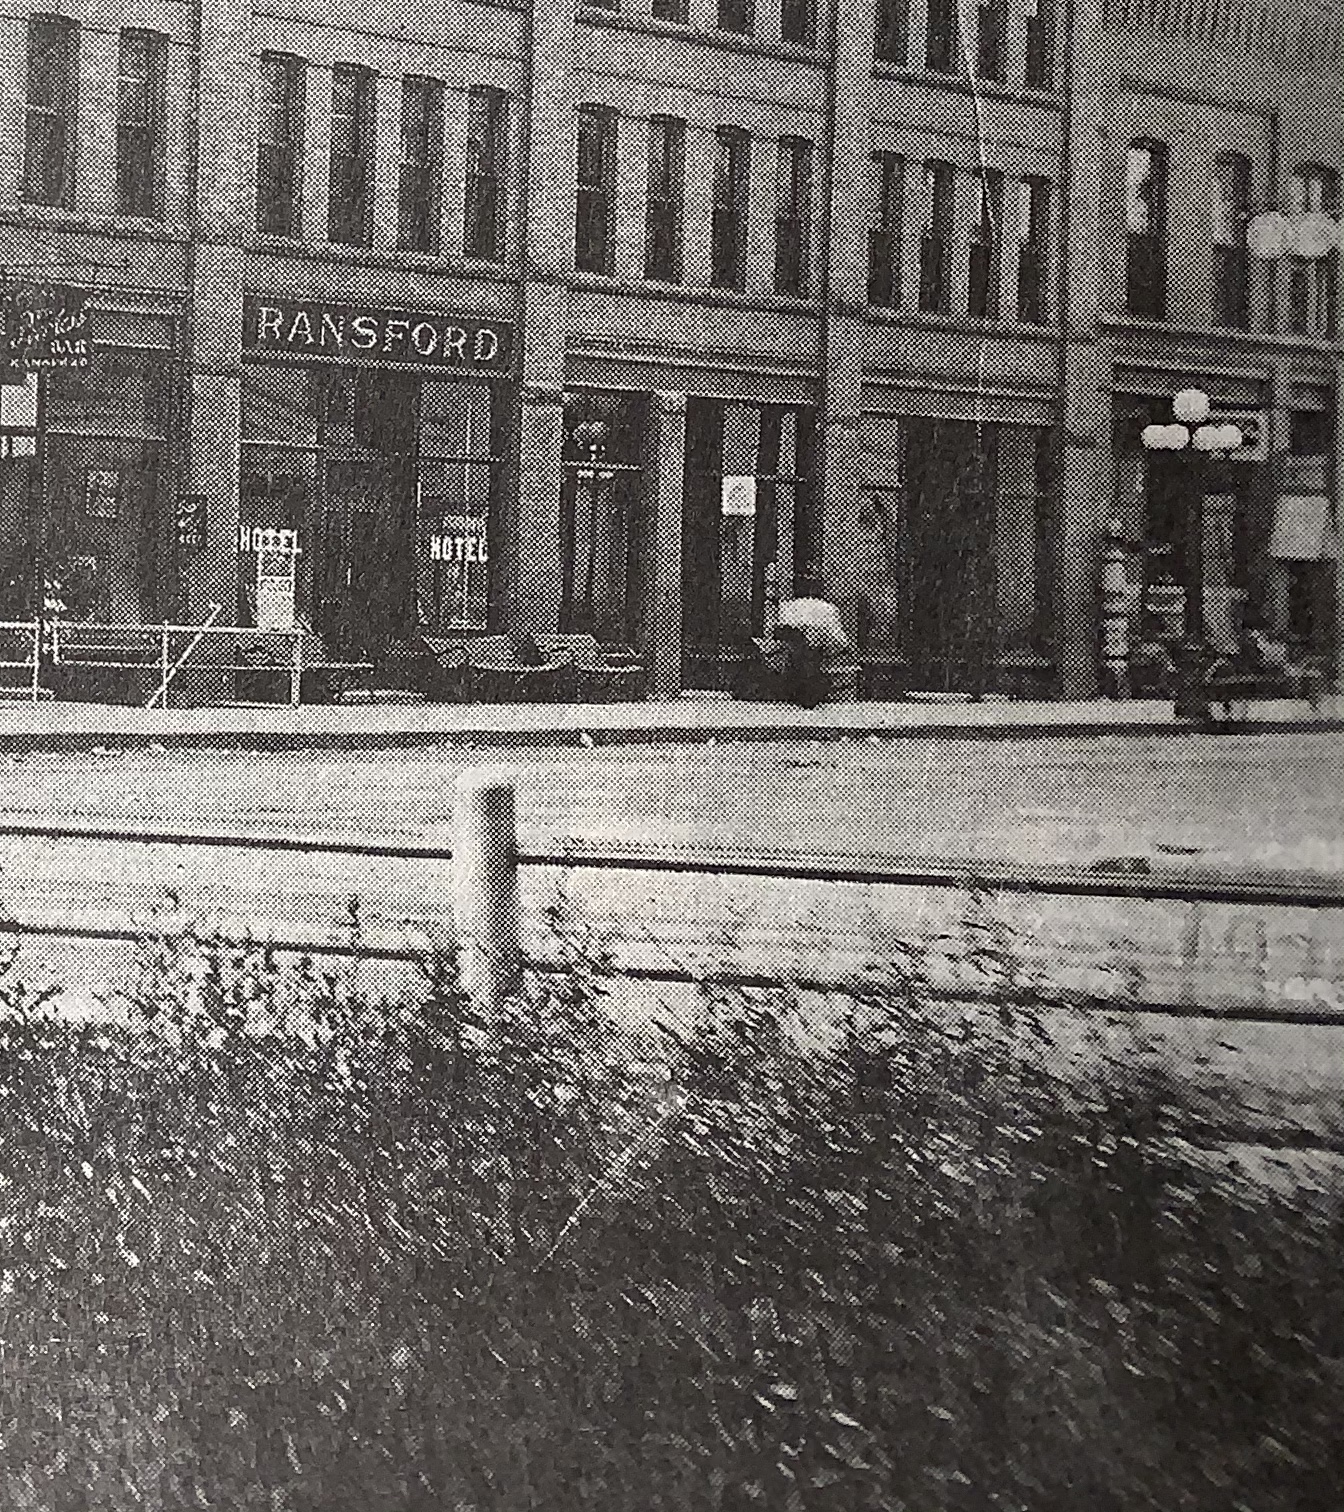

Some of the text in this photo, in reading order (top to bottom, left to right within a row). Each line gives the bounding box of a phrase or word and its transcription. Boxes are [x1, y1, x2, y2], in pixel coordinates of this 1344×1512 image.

[257, 306, 500, 361] RANSFORD
[240, 525, 302, 553] HOTEL
[430, 535, 489, 563] HOTEL
